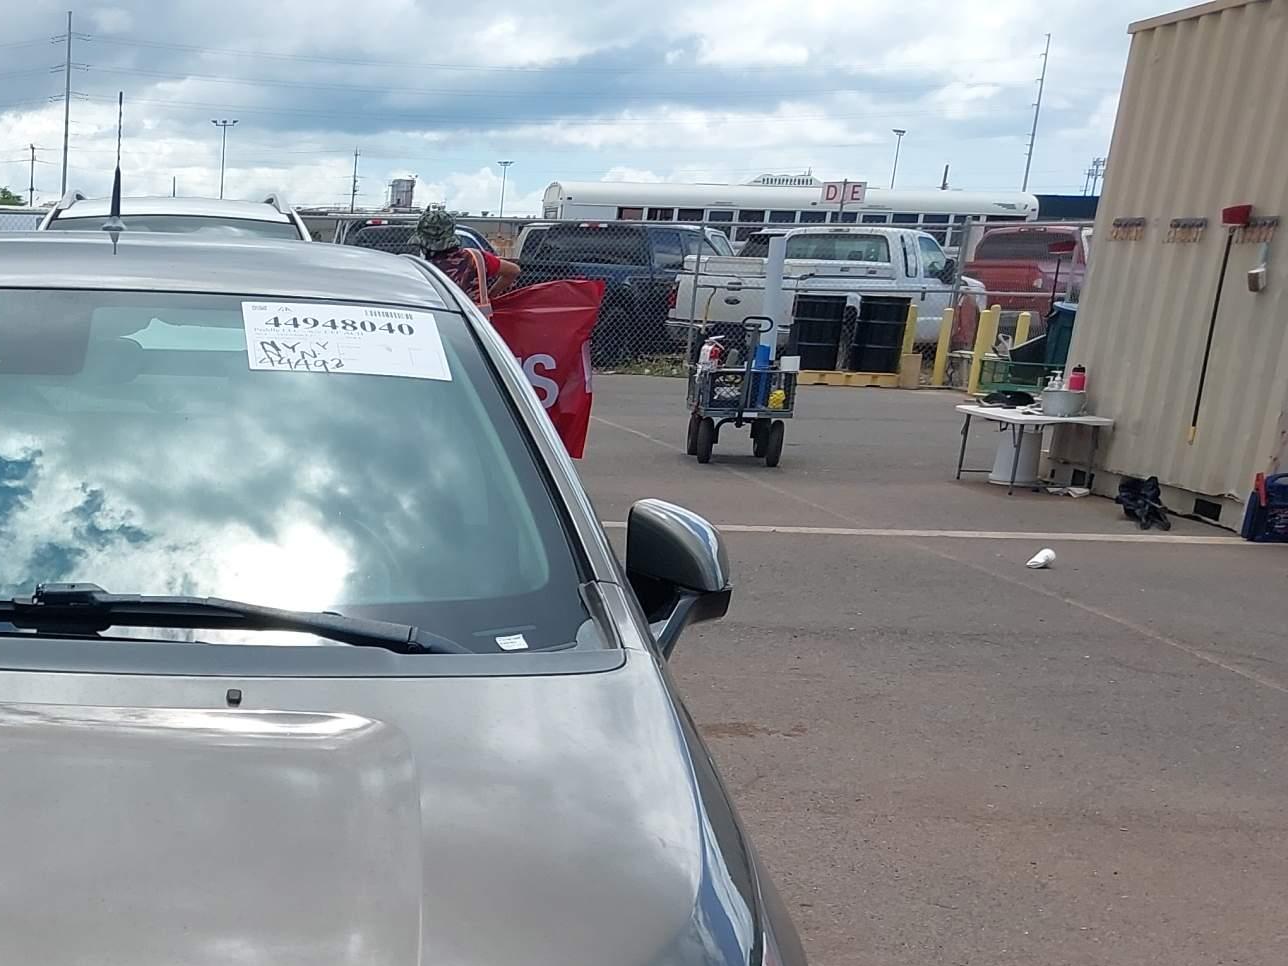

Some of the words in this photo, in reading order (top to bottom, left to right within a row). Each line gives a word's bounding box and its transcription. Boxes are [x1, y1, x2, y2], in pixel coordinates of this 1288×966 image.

[825, 184, 838, 201] D
[850, 184, 862, 201] E
[264, 316, 415, 336] 44948040
